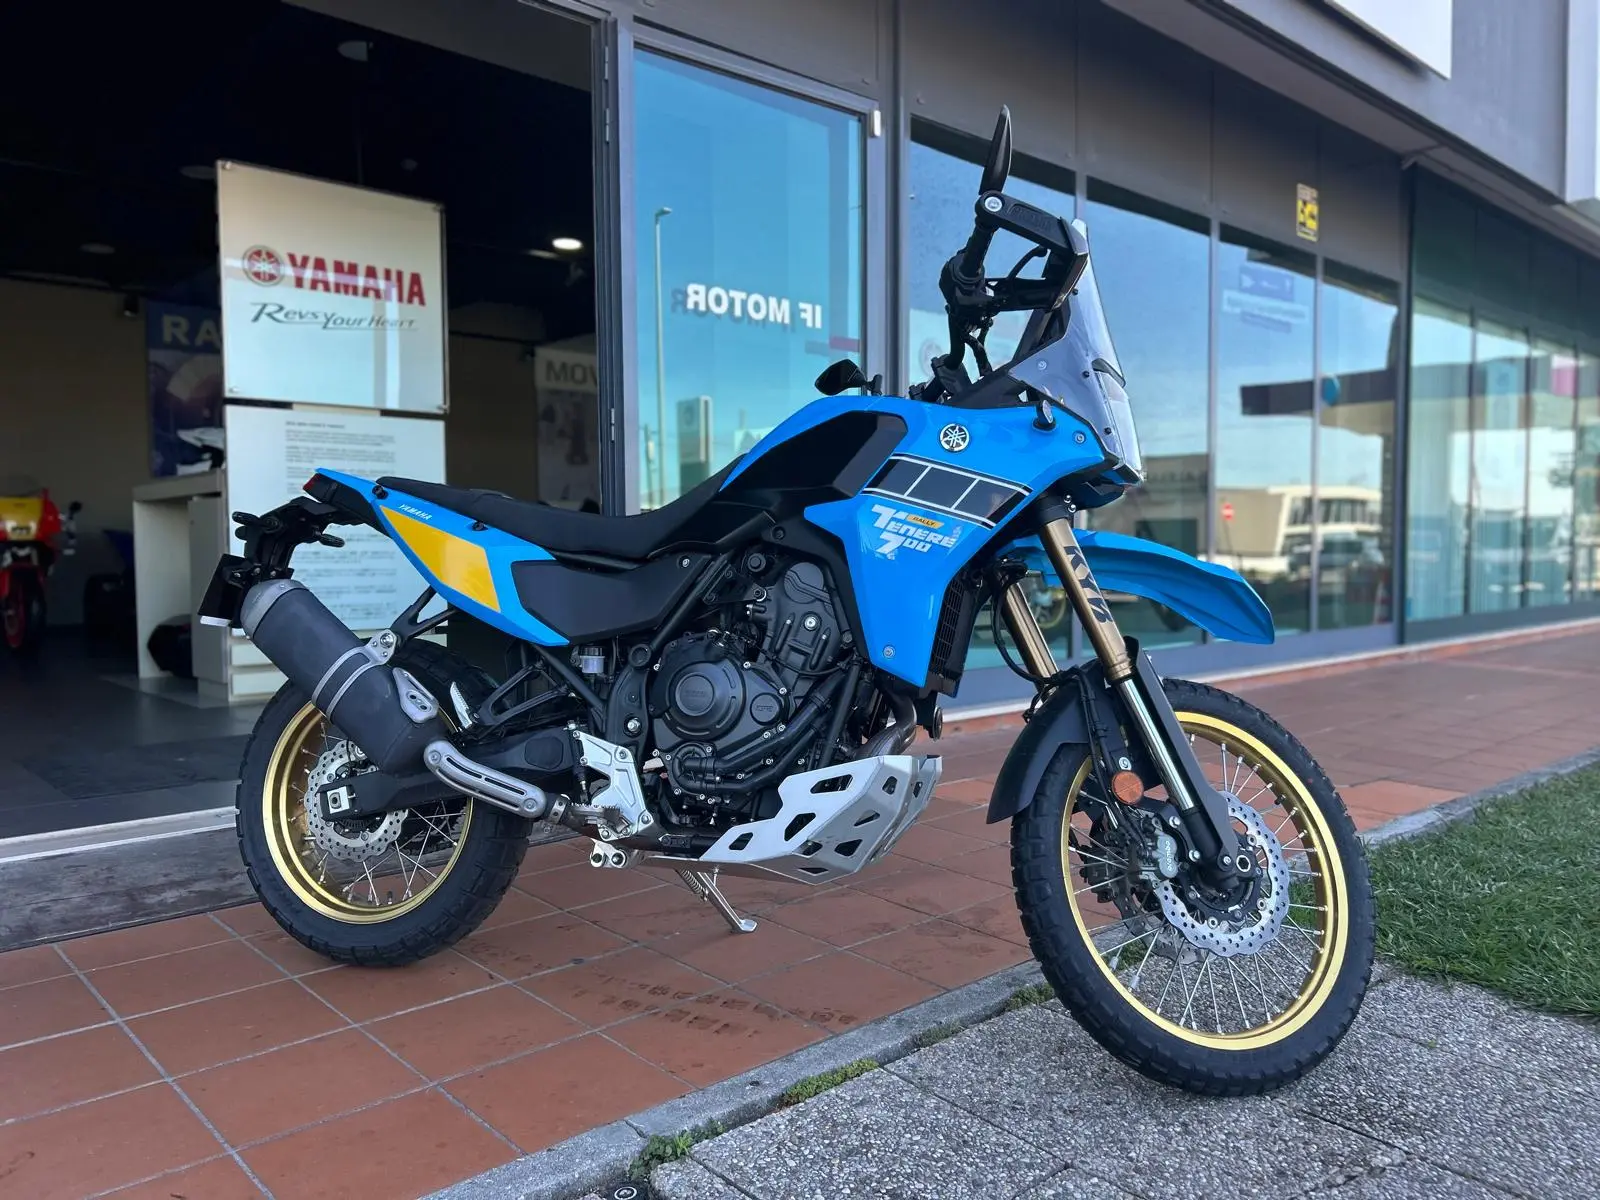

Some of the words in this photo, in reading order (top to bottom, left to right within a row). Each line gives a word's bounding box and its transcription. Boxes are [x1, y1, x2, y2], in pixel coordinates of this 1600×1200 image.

[287, 252, 426, 306] YAMAHA
[398, 503, 433, 521] YAMAHA
[876, 532, 932, 555] 700
[1063, 545, 1113, 623] KYB
